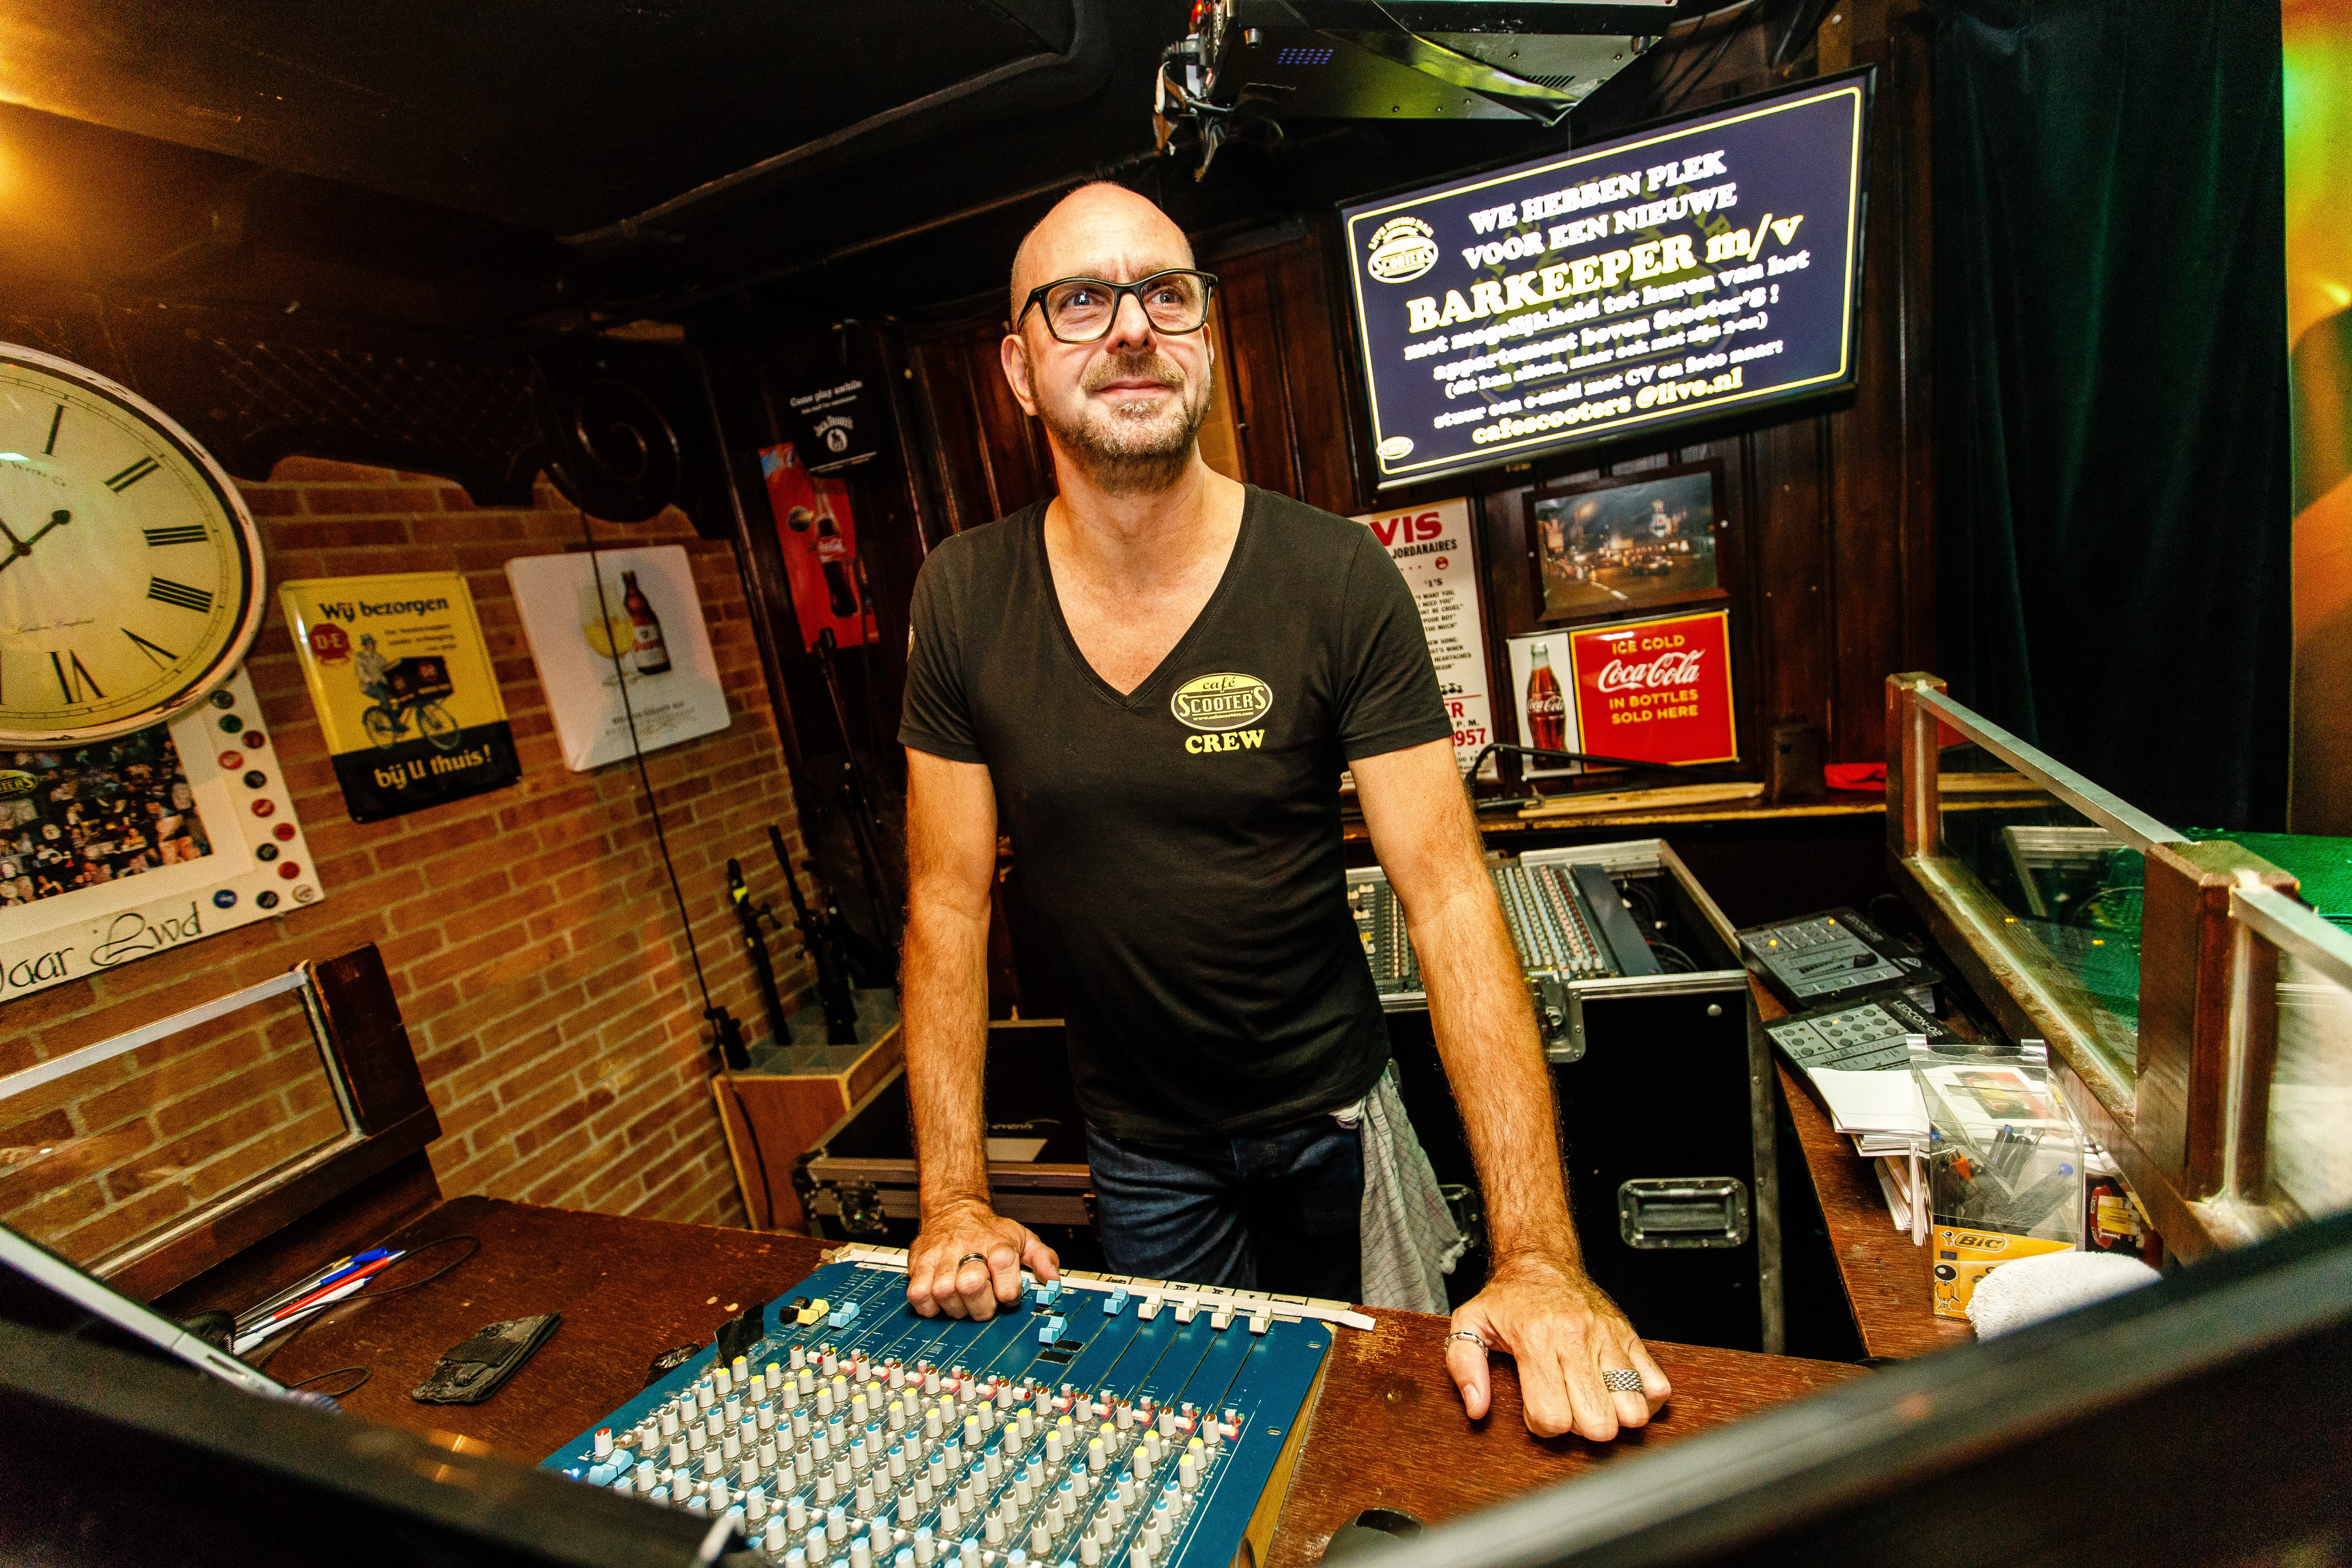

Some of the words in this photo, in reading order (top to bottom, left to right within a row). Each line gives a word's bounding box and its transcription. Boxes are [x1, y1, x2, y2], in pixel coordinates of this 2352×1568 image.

[1469, 203, 1518, 234] WE
[1521, 171, 1641, 223] HEBBEN
[1646, 150, 1727, 191] PLEK
[1462, 231, 1545, 270] VOOR
[1548, 214, 1609, 250] EEN
[1613, 182, 1737, 234] NIEUWE
[1406, 234, 1697, 333] BARKEEPER
[1705, 213, 1803, 263] m/v
[1404, 335, 1448, 360] met
[1451, 298, 1600, 349] mogelijkheid
[1603, 291, 1639, 314] tot
[1642, 275, 1715, 305] huren
[1718, 263, 1764, 286] van
[1767, 250, 1810, 276] het
[1433, 332, 1578, 381] appartement
[1580, 318, 1650, 346] boven
[1445, 379, 1478, 399] (dit
[1478, 373, 1512, 389] kan
[1513, 361, 1568, 381] alleen,
[1570, 349, 1614, 369] maar
[1615, 340, 1650, 358] ook
[1651, 331, 1685, 351] met
[1687, 324, 1721, 343] zijn
[1434, 407, 1487, 429] stuur
[1488, 399, 1522, 416] een
[1524, 381, 1582, 409] e-mail
[1584, 374, 1623, 395] met
[1625, 365, 1656, 386] CV
[1658, 363, 1683, 379] en
[1685, 353, 1727, 373] foto
[1729, 340, 1783, 363] naar:
[1472, 396, 1631, 444] cafescooters
[1636, 366, 1743, 408] @live.nl
[1392, 538, 1458, 559] JORDANAIRES
[318, 602, 355, 622] Wij
[359, 598, 449, 616] bezorgen
[1435, 652, 1472, 662] HEARTACHES
[1612, 640, 1637, 655] ICE
[1642, 635, 1685, 651] COLD
[1203, 677, 1236, 691] café
[1609, 698, 1625, 710] IN
[1629, 689, 1698, 707] BOTTLES
[1193, 711, 1254, 721] www.cafescooters.com
[1612, 710, 1652, 725] SOLD
[1657, 704, 1698, 720] HERE
[1185, 729, 1265, 753] CREW
[1450, 727, 1486, 746] 1957
[374, 763, 407, 790] bij
[407, 759, 427, 780] U
[1894, 1000, 1943, 1036] LEDCON-02
